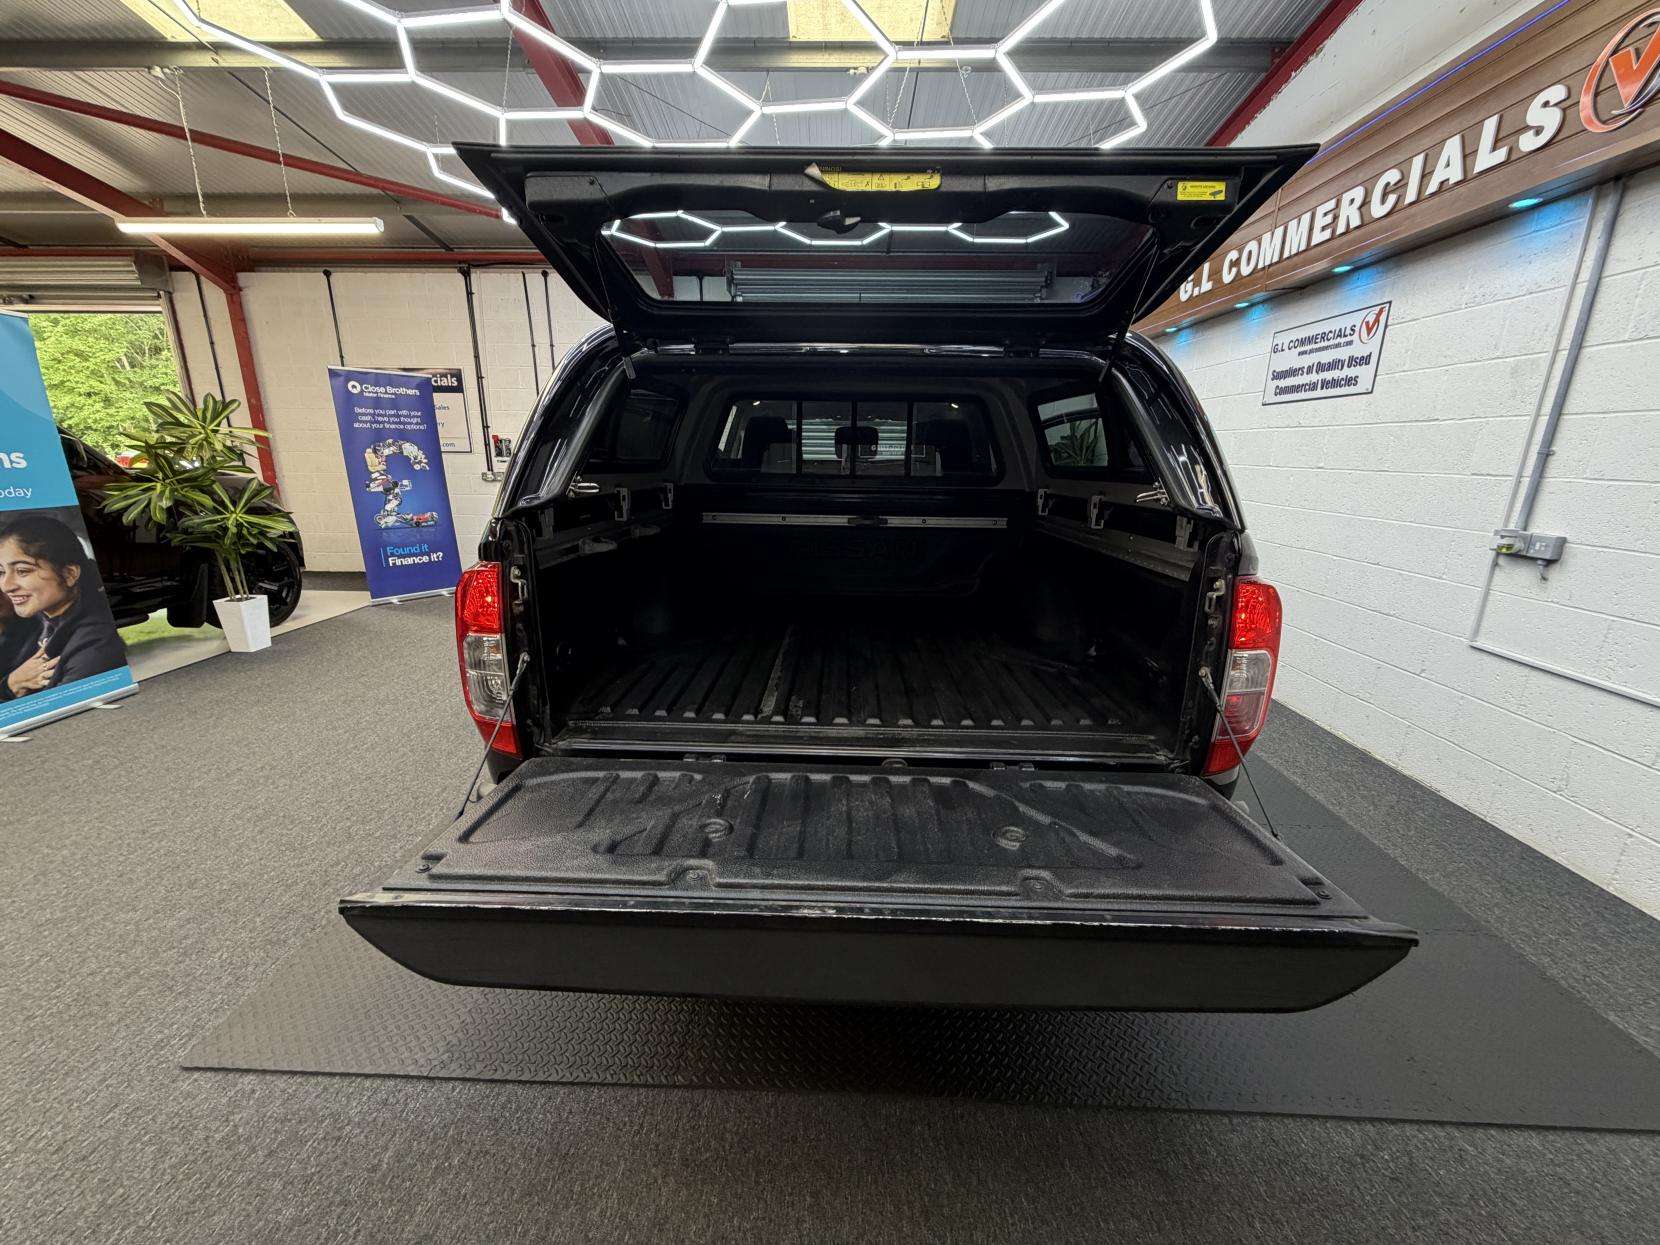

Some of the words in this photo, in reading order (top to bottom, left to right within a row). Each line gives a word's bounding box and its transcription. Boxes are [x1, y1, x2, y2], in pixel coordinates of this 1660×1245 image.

[1179, 262, 1213, 303] G.L
[1222, 83, 1570, 285] COMMERCIALS
[1273, 343, 1286, 354] G.L
[1287, 324, 1356, 351] COMMERCIALS
[1271, 366, 1305, 382] Suppliers
[1306, 364, 1315, 376] of
[1315, 356, 1348, 375] Quality
[1348, 351, 1372, 367] Used
[362, 384, 386, 394] Close
[387, 386, 420, 396] Brothers
[1274, 381, 1319, 397] Commercial
[1320, 374, 1359, 390] Vehicles
[354, 406, 374, 414] Before
[386, 544, 421, 556] Found
[421, 543, 430, 552] it
[388, 555, 430, 567] Finance
[430, 551, 443, 562] it?
